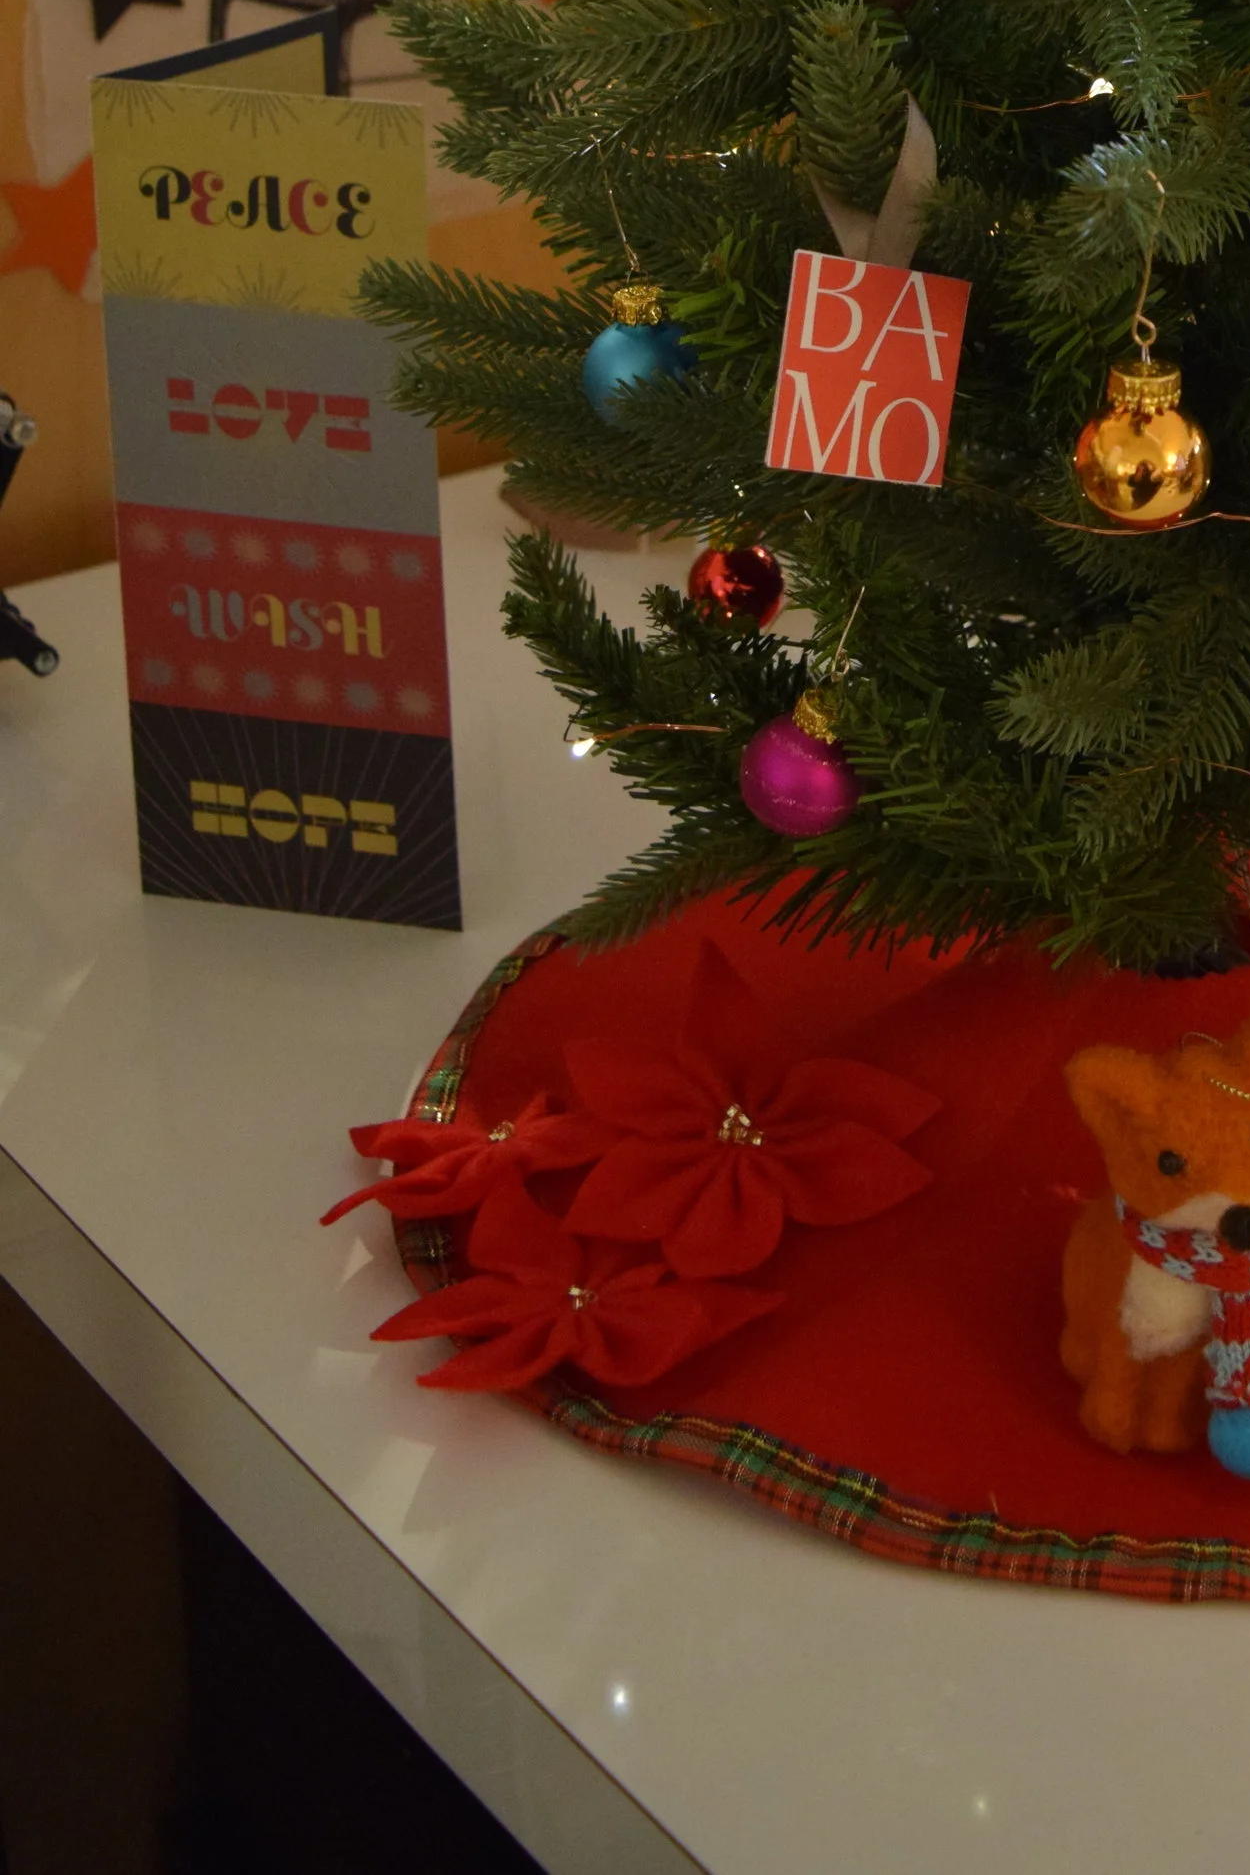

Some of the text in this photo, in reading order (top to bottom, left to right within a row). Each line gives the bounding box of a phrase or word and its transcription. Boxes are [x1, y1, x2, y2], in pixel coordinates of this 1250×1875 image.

[139, 165, 377, 240] PEACE
[800, 252, 948, 381] BA
[167, 378, 371, 452] LOVE
[782, 368, 940, 485] MO
[190, 781, 398, 857] HOPE
